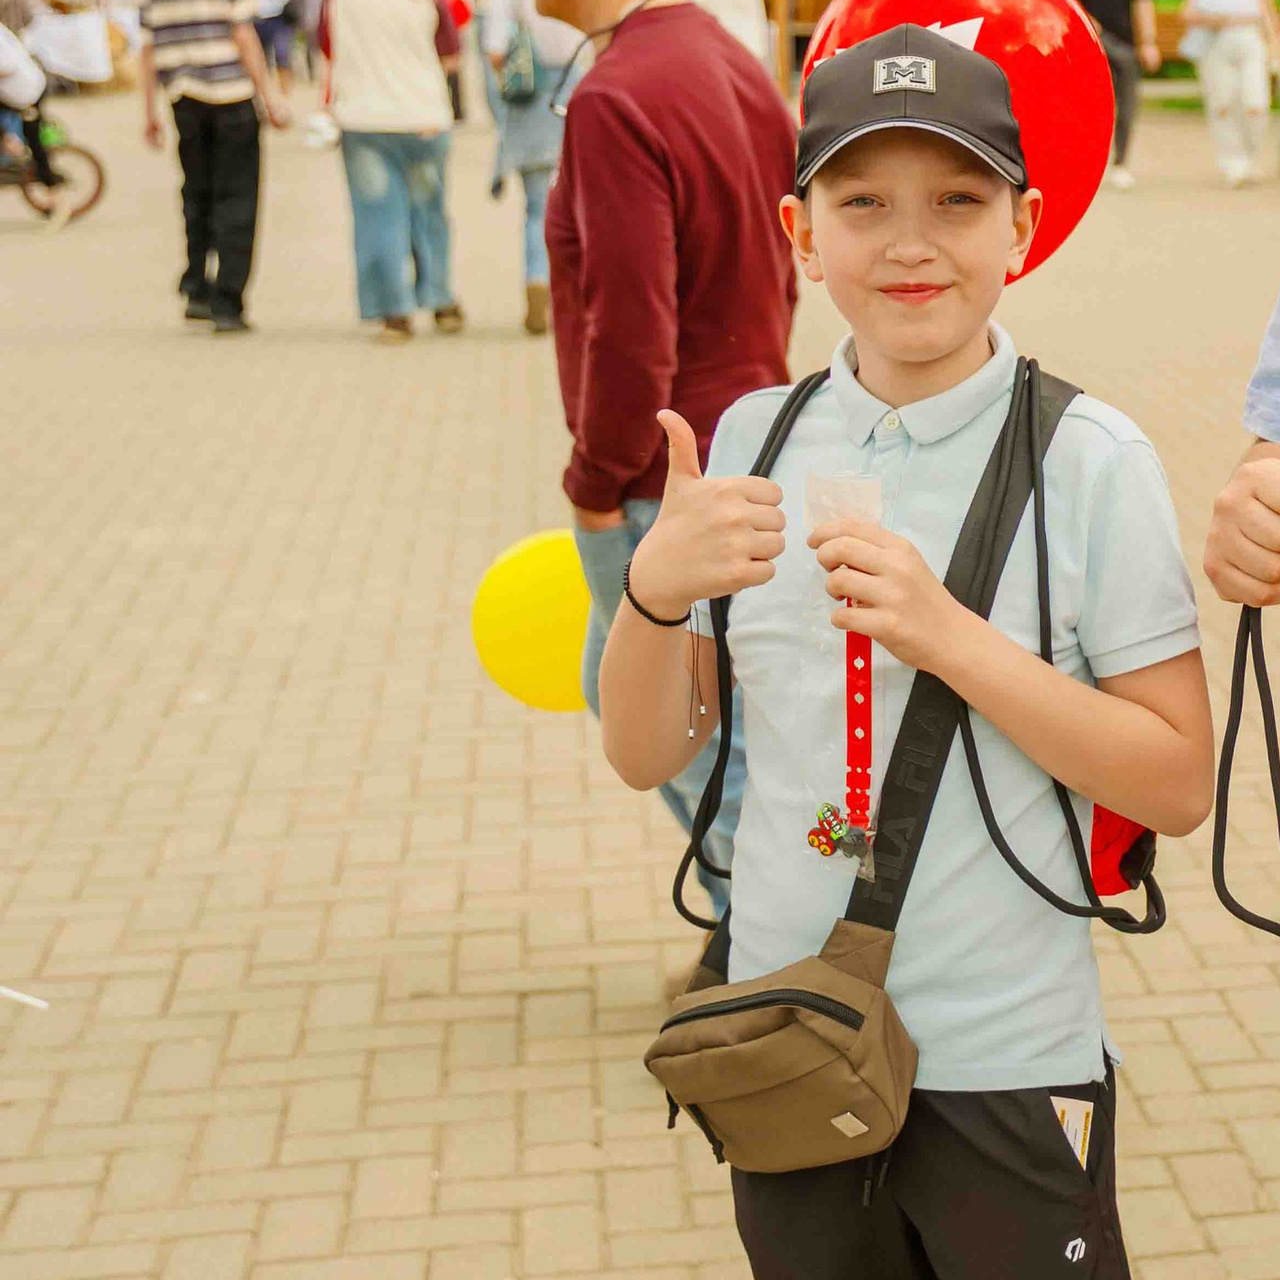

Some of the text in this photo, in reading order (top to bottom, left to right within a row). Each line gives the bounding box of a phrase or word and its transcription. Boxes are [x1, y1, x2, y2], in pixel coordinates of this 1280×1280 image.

[882, 61, 927, 85] M
[863, 709, 944, 903] FILA FILA
